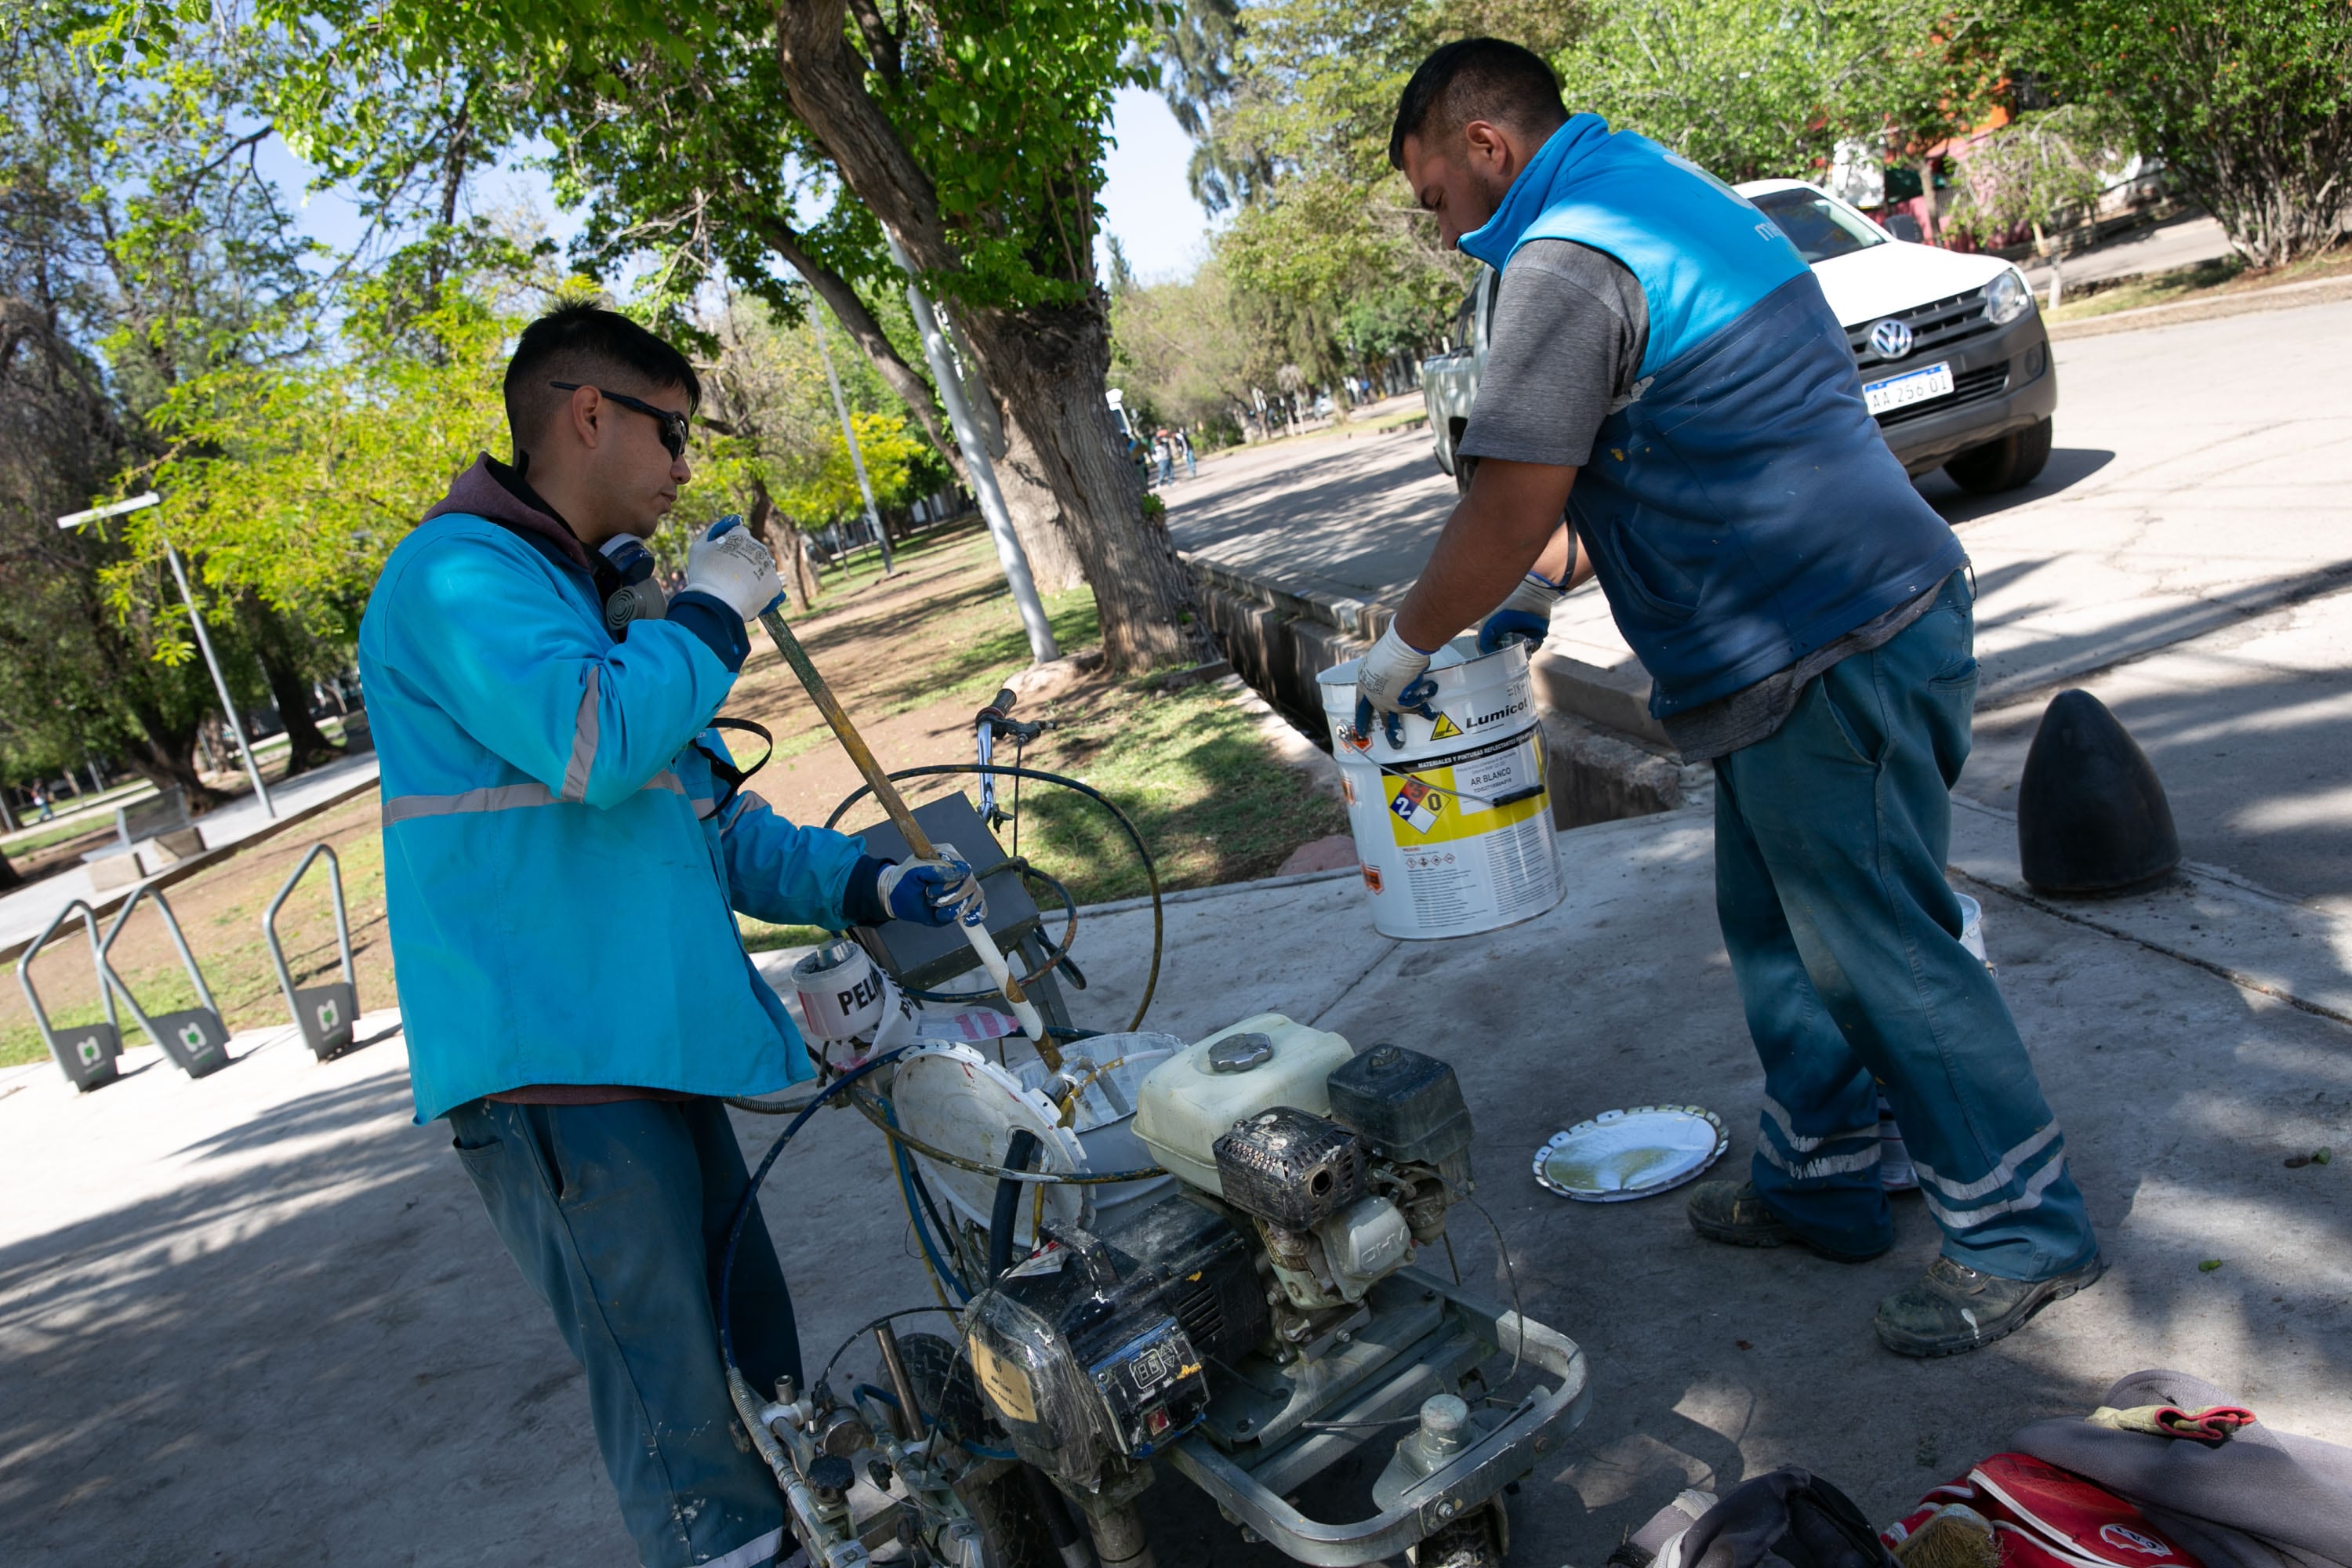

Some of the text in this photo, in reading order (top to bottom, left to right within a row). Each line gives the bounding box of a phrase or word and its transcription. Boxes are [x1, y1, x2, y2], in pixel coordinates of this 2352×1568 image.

[1873, 391, 1890, 408] AA
[1897, 382, 1924, 402] 256
[1417, 757, 1452, 768] MATERIALES
[1457, 750, 1484, 761] PINTURAS
[1471, 777, 1481, 786] AR
[1483, 767, 1512, 782] BLANCO
[1408, 781, 1424, 799] 3
[1396, 797, 1411, 816] 2
[1427, 793, 1442, 811] 0
